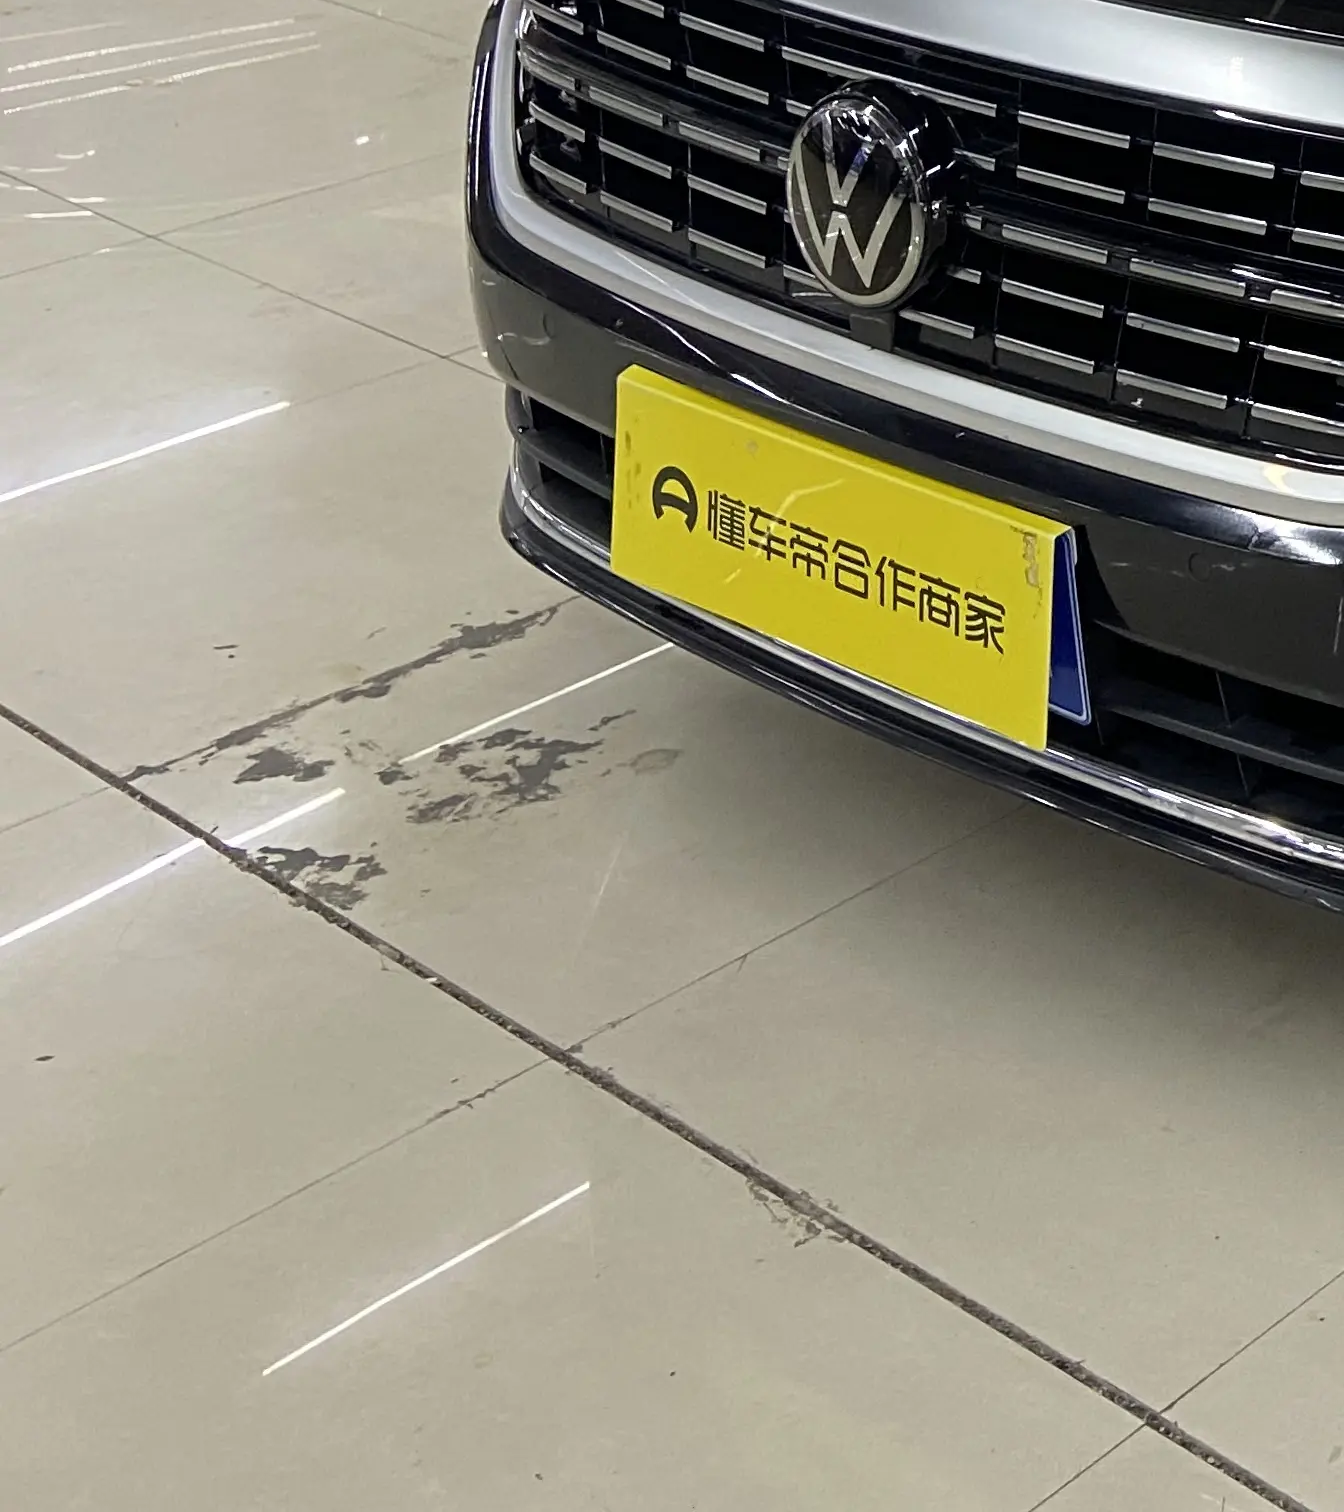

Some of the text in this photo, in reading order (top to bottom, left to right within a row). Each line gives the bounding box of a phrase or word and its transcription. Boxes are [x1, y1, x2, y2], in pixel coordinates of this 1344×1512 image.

[706, 489, 1006, 655] 懂车帝合作商家
